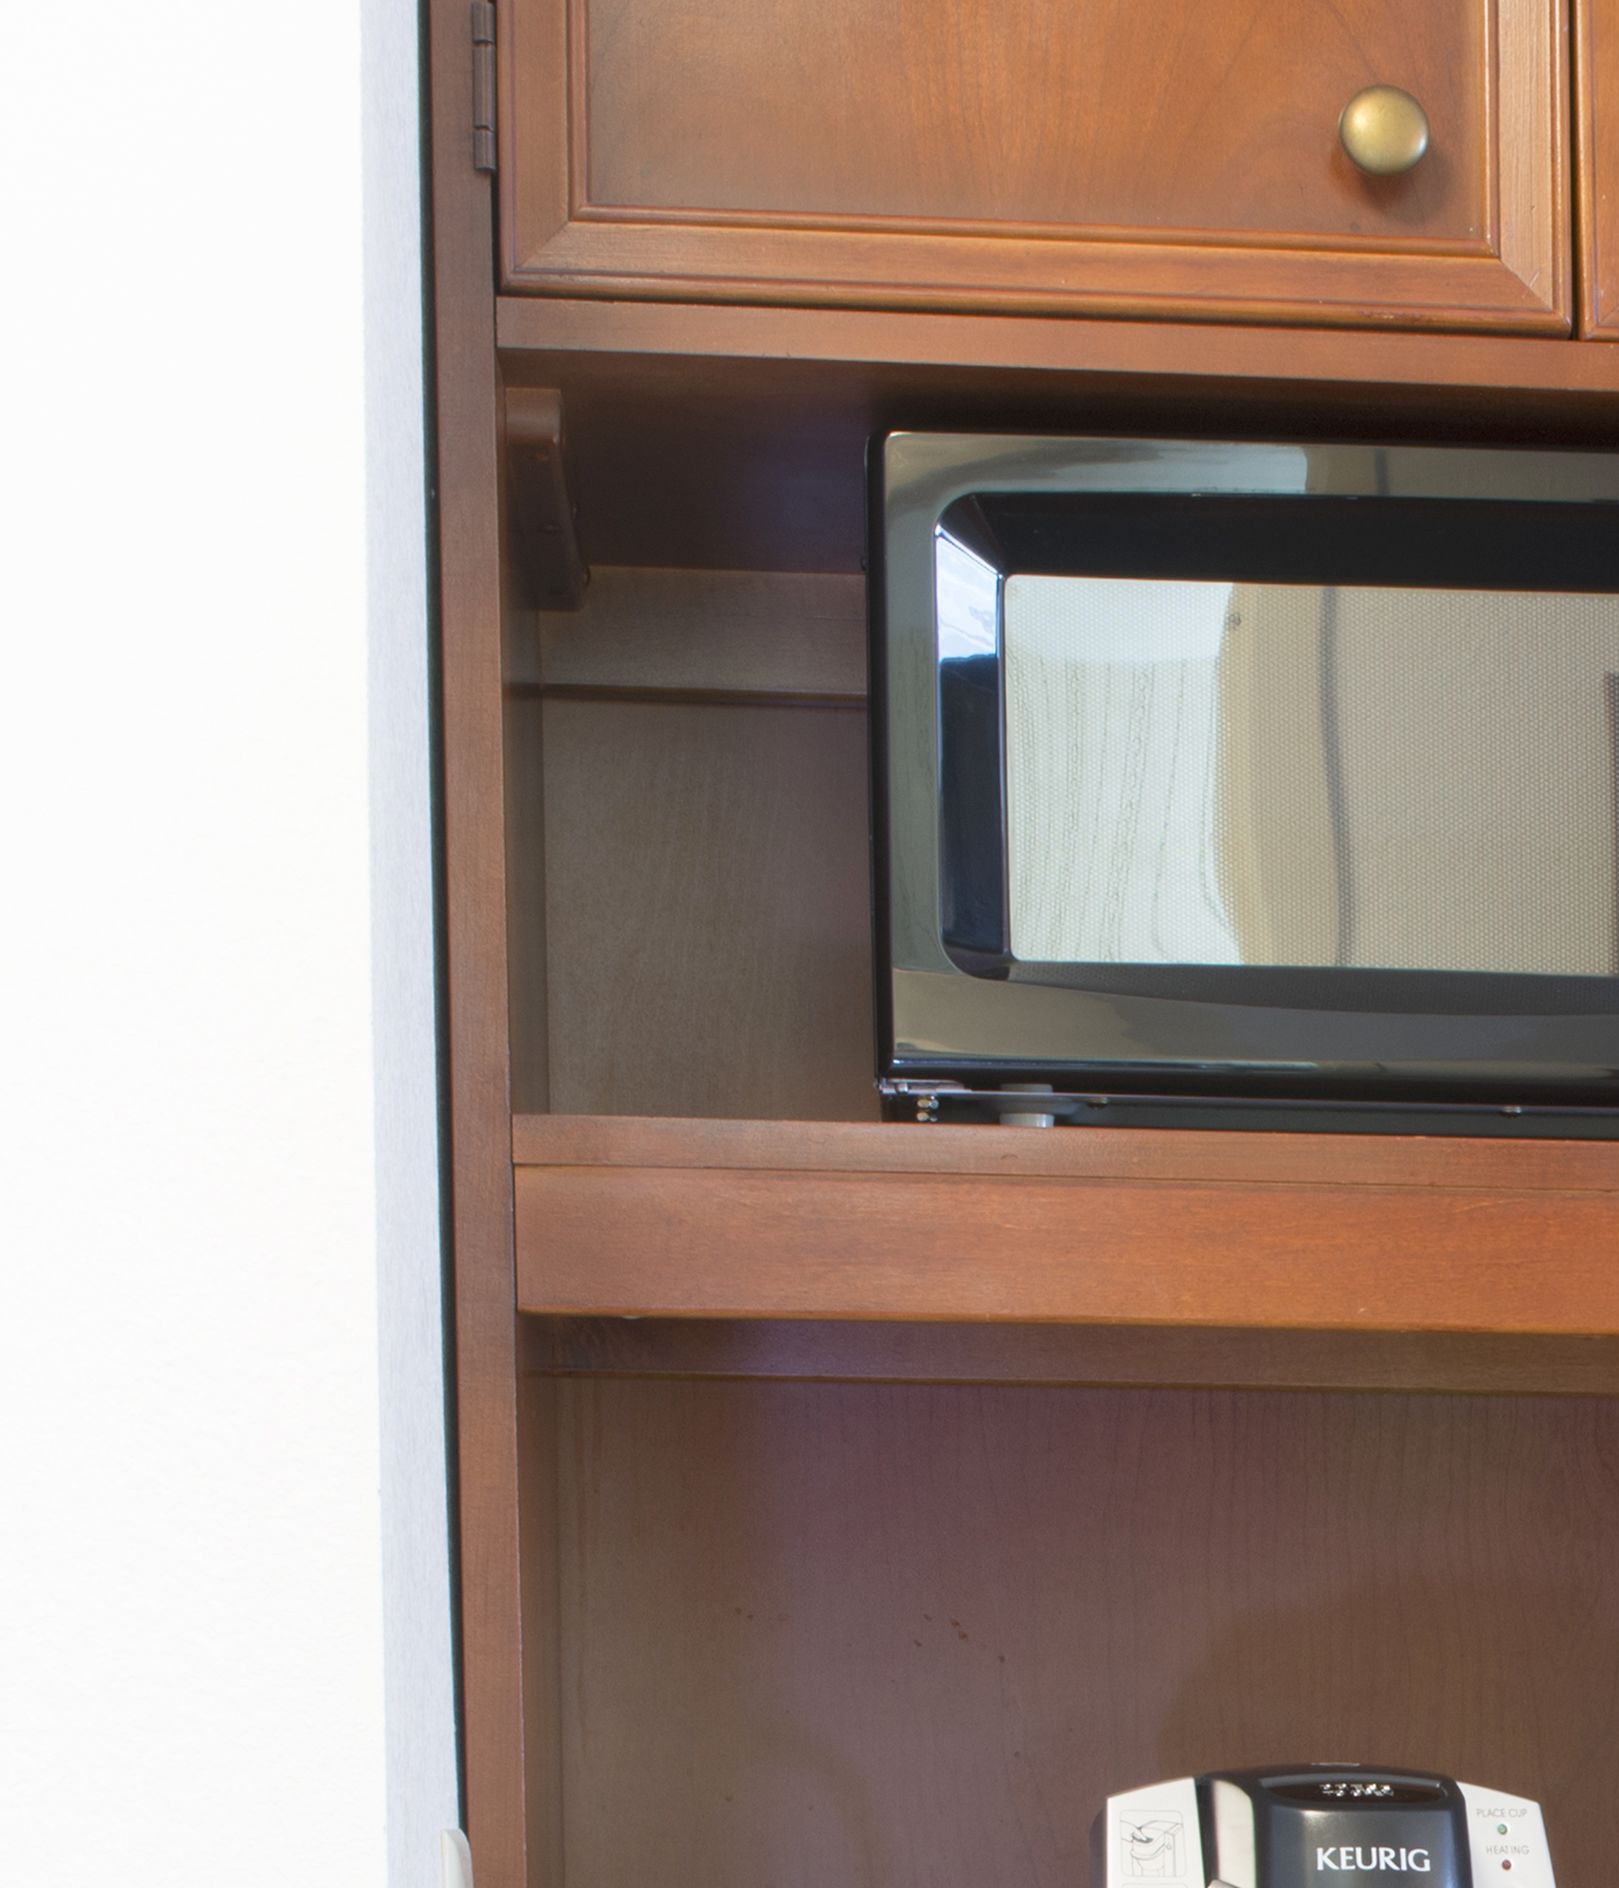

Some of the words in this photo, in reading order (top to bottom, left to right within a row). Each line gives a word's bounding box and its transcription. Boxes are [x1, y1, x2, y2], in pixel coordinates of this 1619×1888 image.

[1476, 1808, 1505, 1817] PLACE
[1508, 1808, 1528, 1818] CUP
[1486, 1845, 1530, 1855] HEATING
[1316, 1847, 1431, 1872] KEURIG
